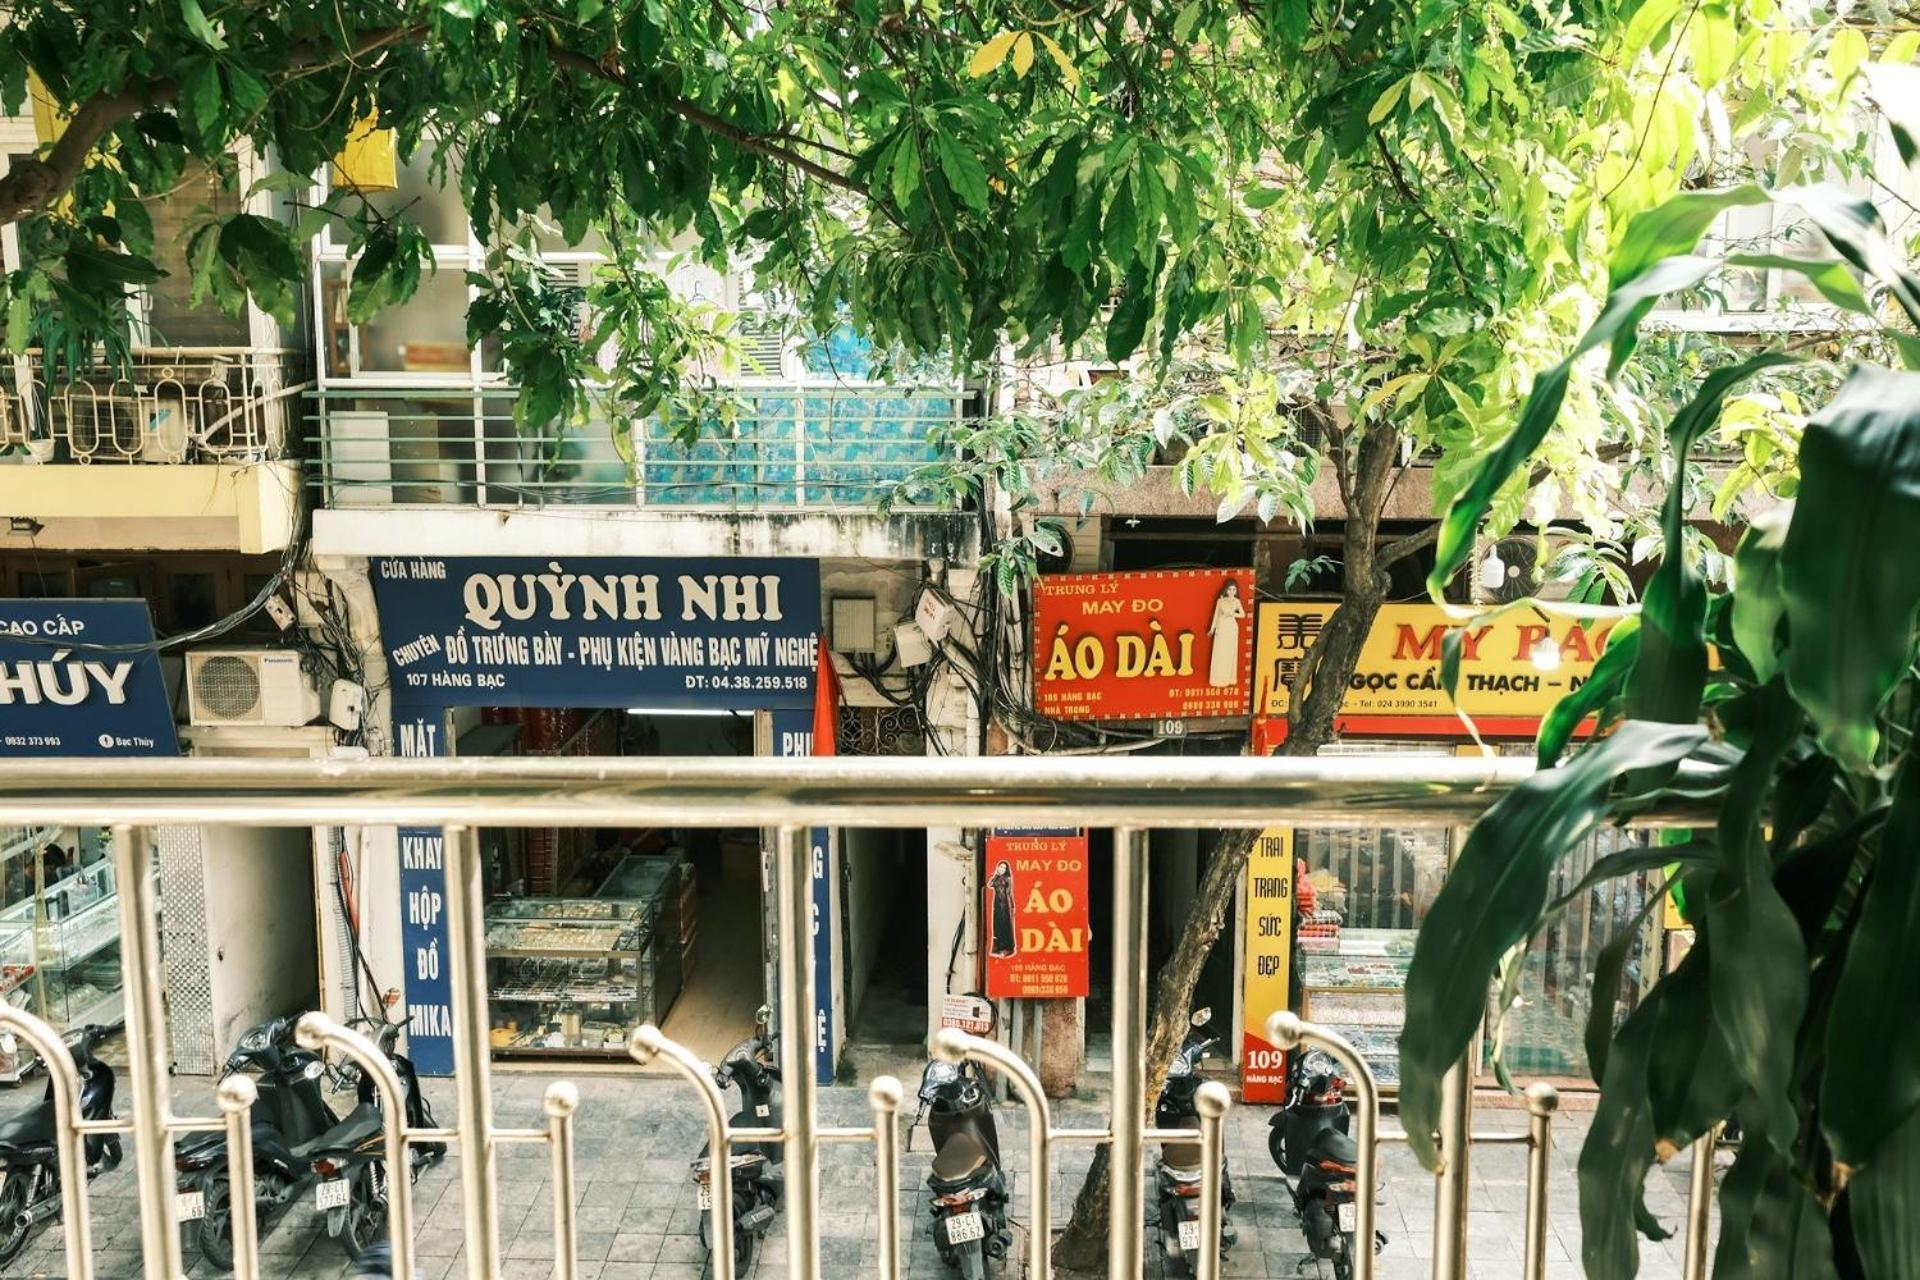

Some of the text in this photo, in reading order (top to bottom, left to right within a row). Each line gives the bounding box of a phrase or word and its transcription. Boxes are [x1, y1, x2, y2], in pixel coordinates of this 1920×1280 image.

[411, 556, 446, 579] HÀNG
[463, 561, 783, 630] QUỲNH NHI
[1046, 580, 1119, 596] TRUNG LÝ
[1082, 599, 1163, 615] MAY ĐO
[0, 613, 85, 636] CAO CẤP
[392, 634, 441, 667] CHUYÊN
[445, 626, 468, 664] ĐỒ
[472, 632, 529, 665] TRƯNG
[532, 630, 562, 665] BÀY
[579, 636, 612, 671] PHỤ
[617, 631, 657, 671] KIỆN
[660, 631, 704, 666] VÀNG
[708, 637, 741, 671] BẠC
[745, 632, 770, 666] MỸ
[775, 632, 818, 672] NGHỆ
[1044, 620, 1195, 681] ÁO DÀI
[407, 670, 505, 690] 107 HÀNG BẠC
[685, 676, 808, 689] ĐT: 04.38.259.518
[1467, 675, 1539, 695] THẠCH
[1158, 720, 1183, 735] 109
[403, 837, 443, 869] KHAY
[1006, 842, 1048, 851] TRUNG
[1260, 837, 1284, 857] TRAI
[1016, 860, 1082, 871] MAY ĐO
[1023, 881, 1073, 913] ÁO
[1254, 877, 1288, 898] TRANG
[409, 886, 441, 931] HỘP
[1259, 913, 1281, 937] SỨC
[1021, 921, 1083, 953] DÀI
[417, 937, 438, 980] ĐỒ
[1258, 955, 1279, 978] ĐẸP
[409, 1004, 452, 1037] MIKA
[1248, 1050, 1283, 1069] 109
